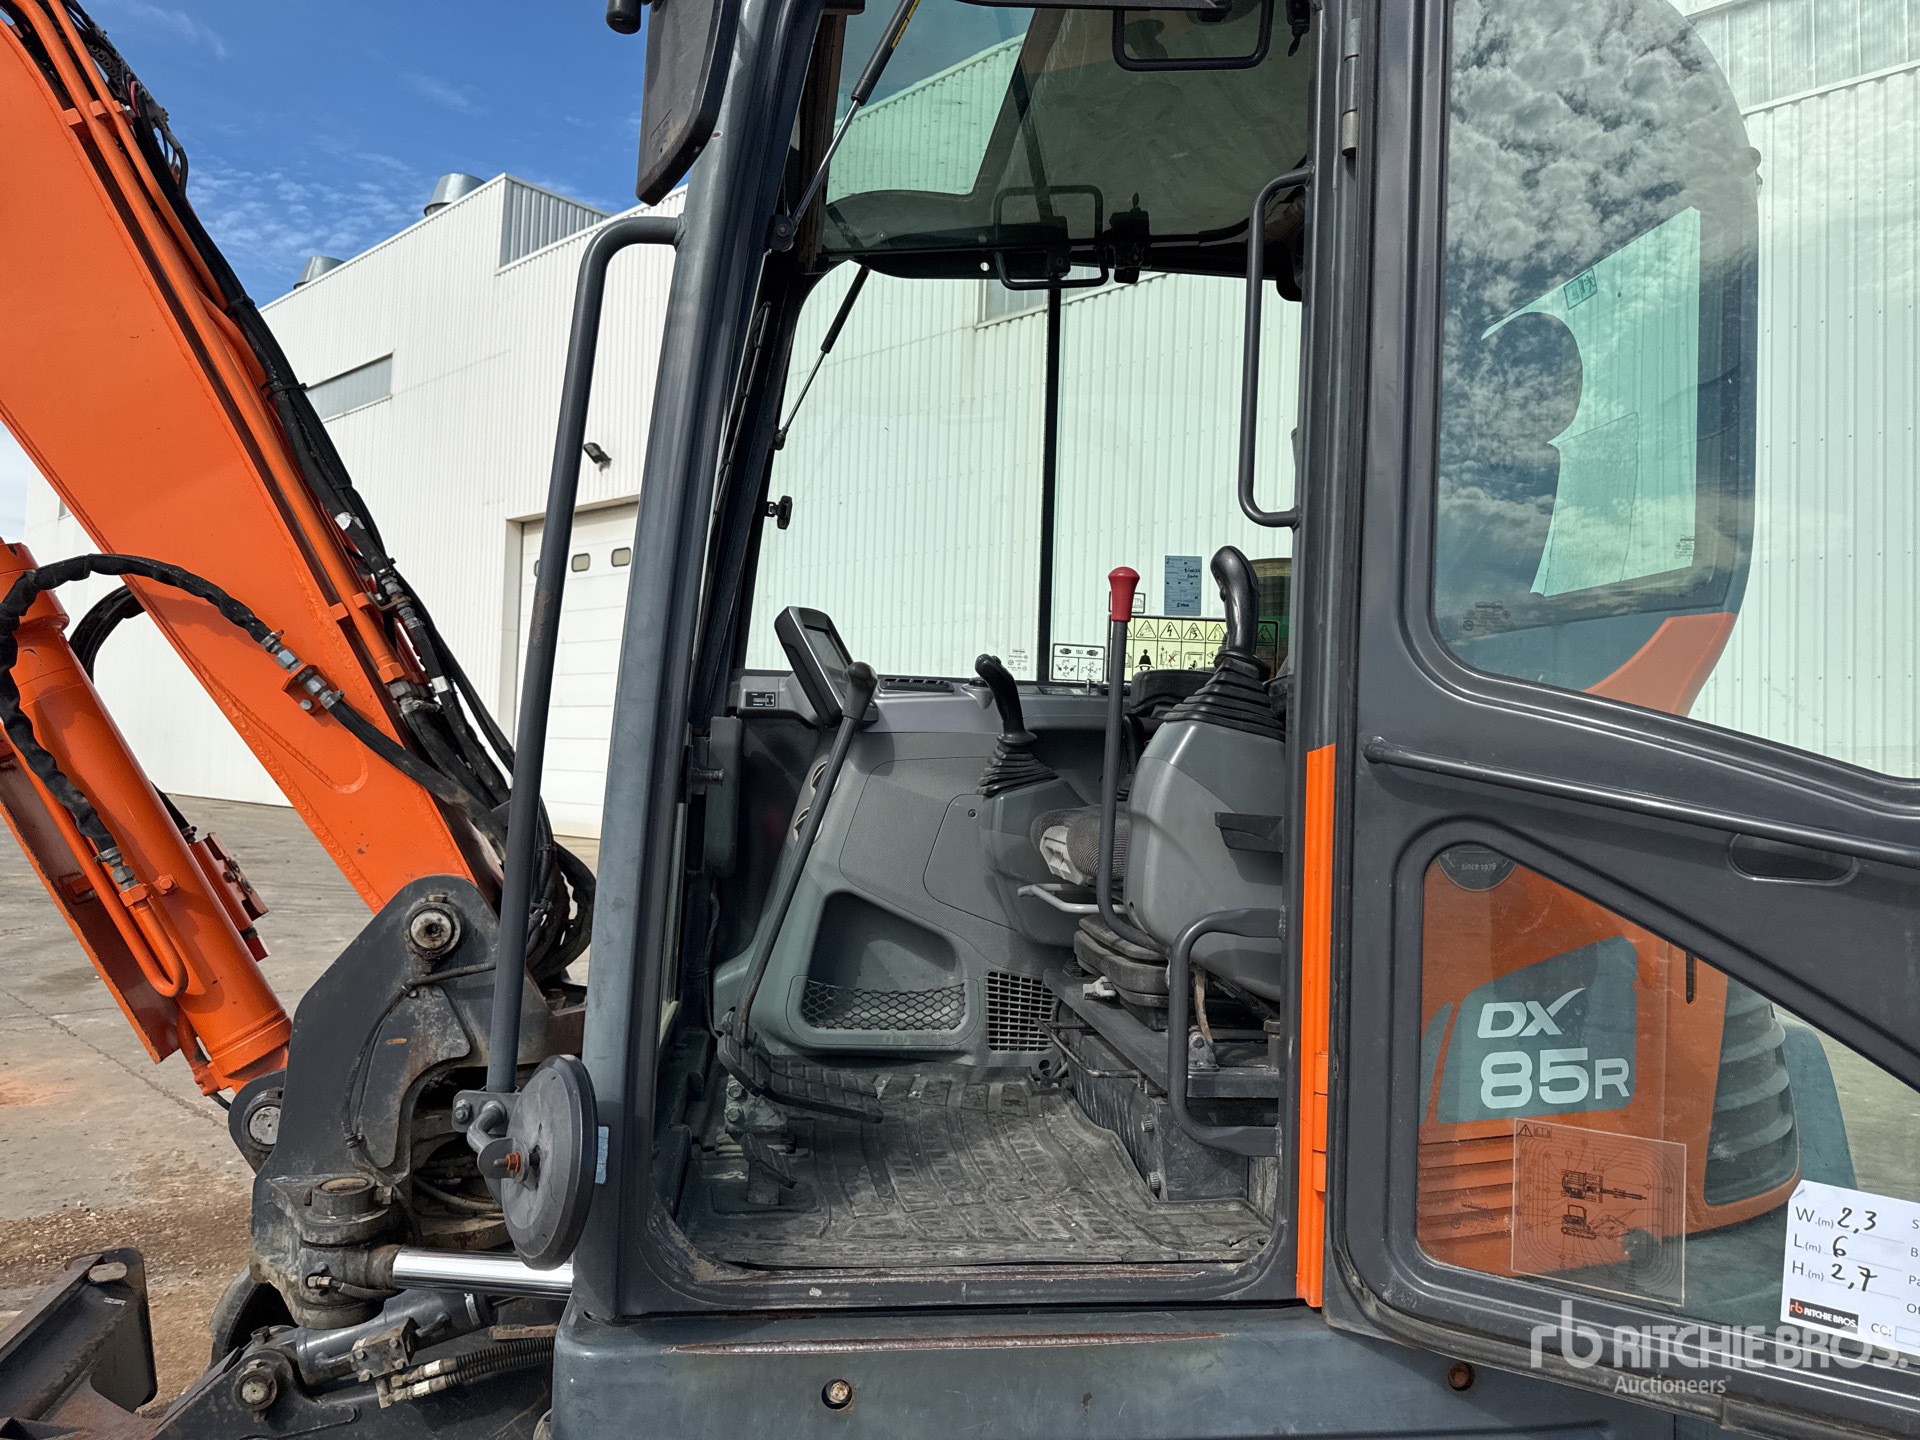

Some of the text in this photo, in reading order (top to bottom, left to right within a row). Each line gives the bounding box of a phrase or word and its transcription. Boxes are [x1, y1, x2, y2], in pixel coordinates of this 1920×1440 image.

[1461, 862, 1497, 873] since 1978
[1477, 987, 1587, 1039] DX
[1837, 1207, 1877, 1234] 2,3
[1832, 1235, 1849, 1258] 6
[1831, 1263, 1878, 1292] 2,7
[1804, 1307, 1833, 1322] RITCHIE
[1832, 1314, 1858, 1328] BROS.
[1870, 1323, 1892, 1337] CC:
